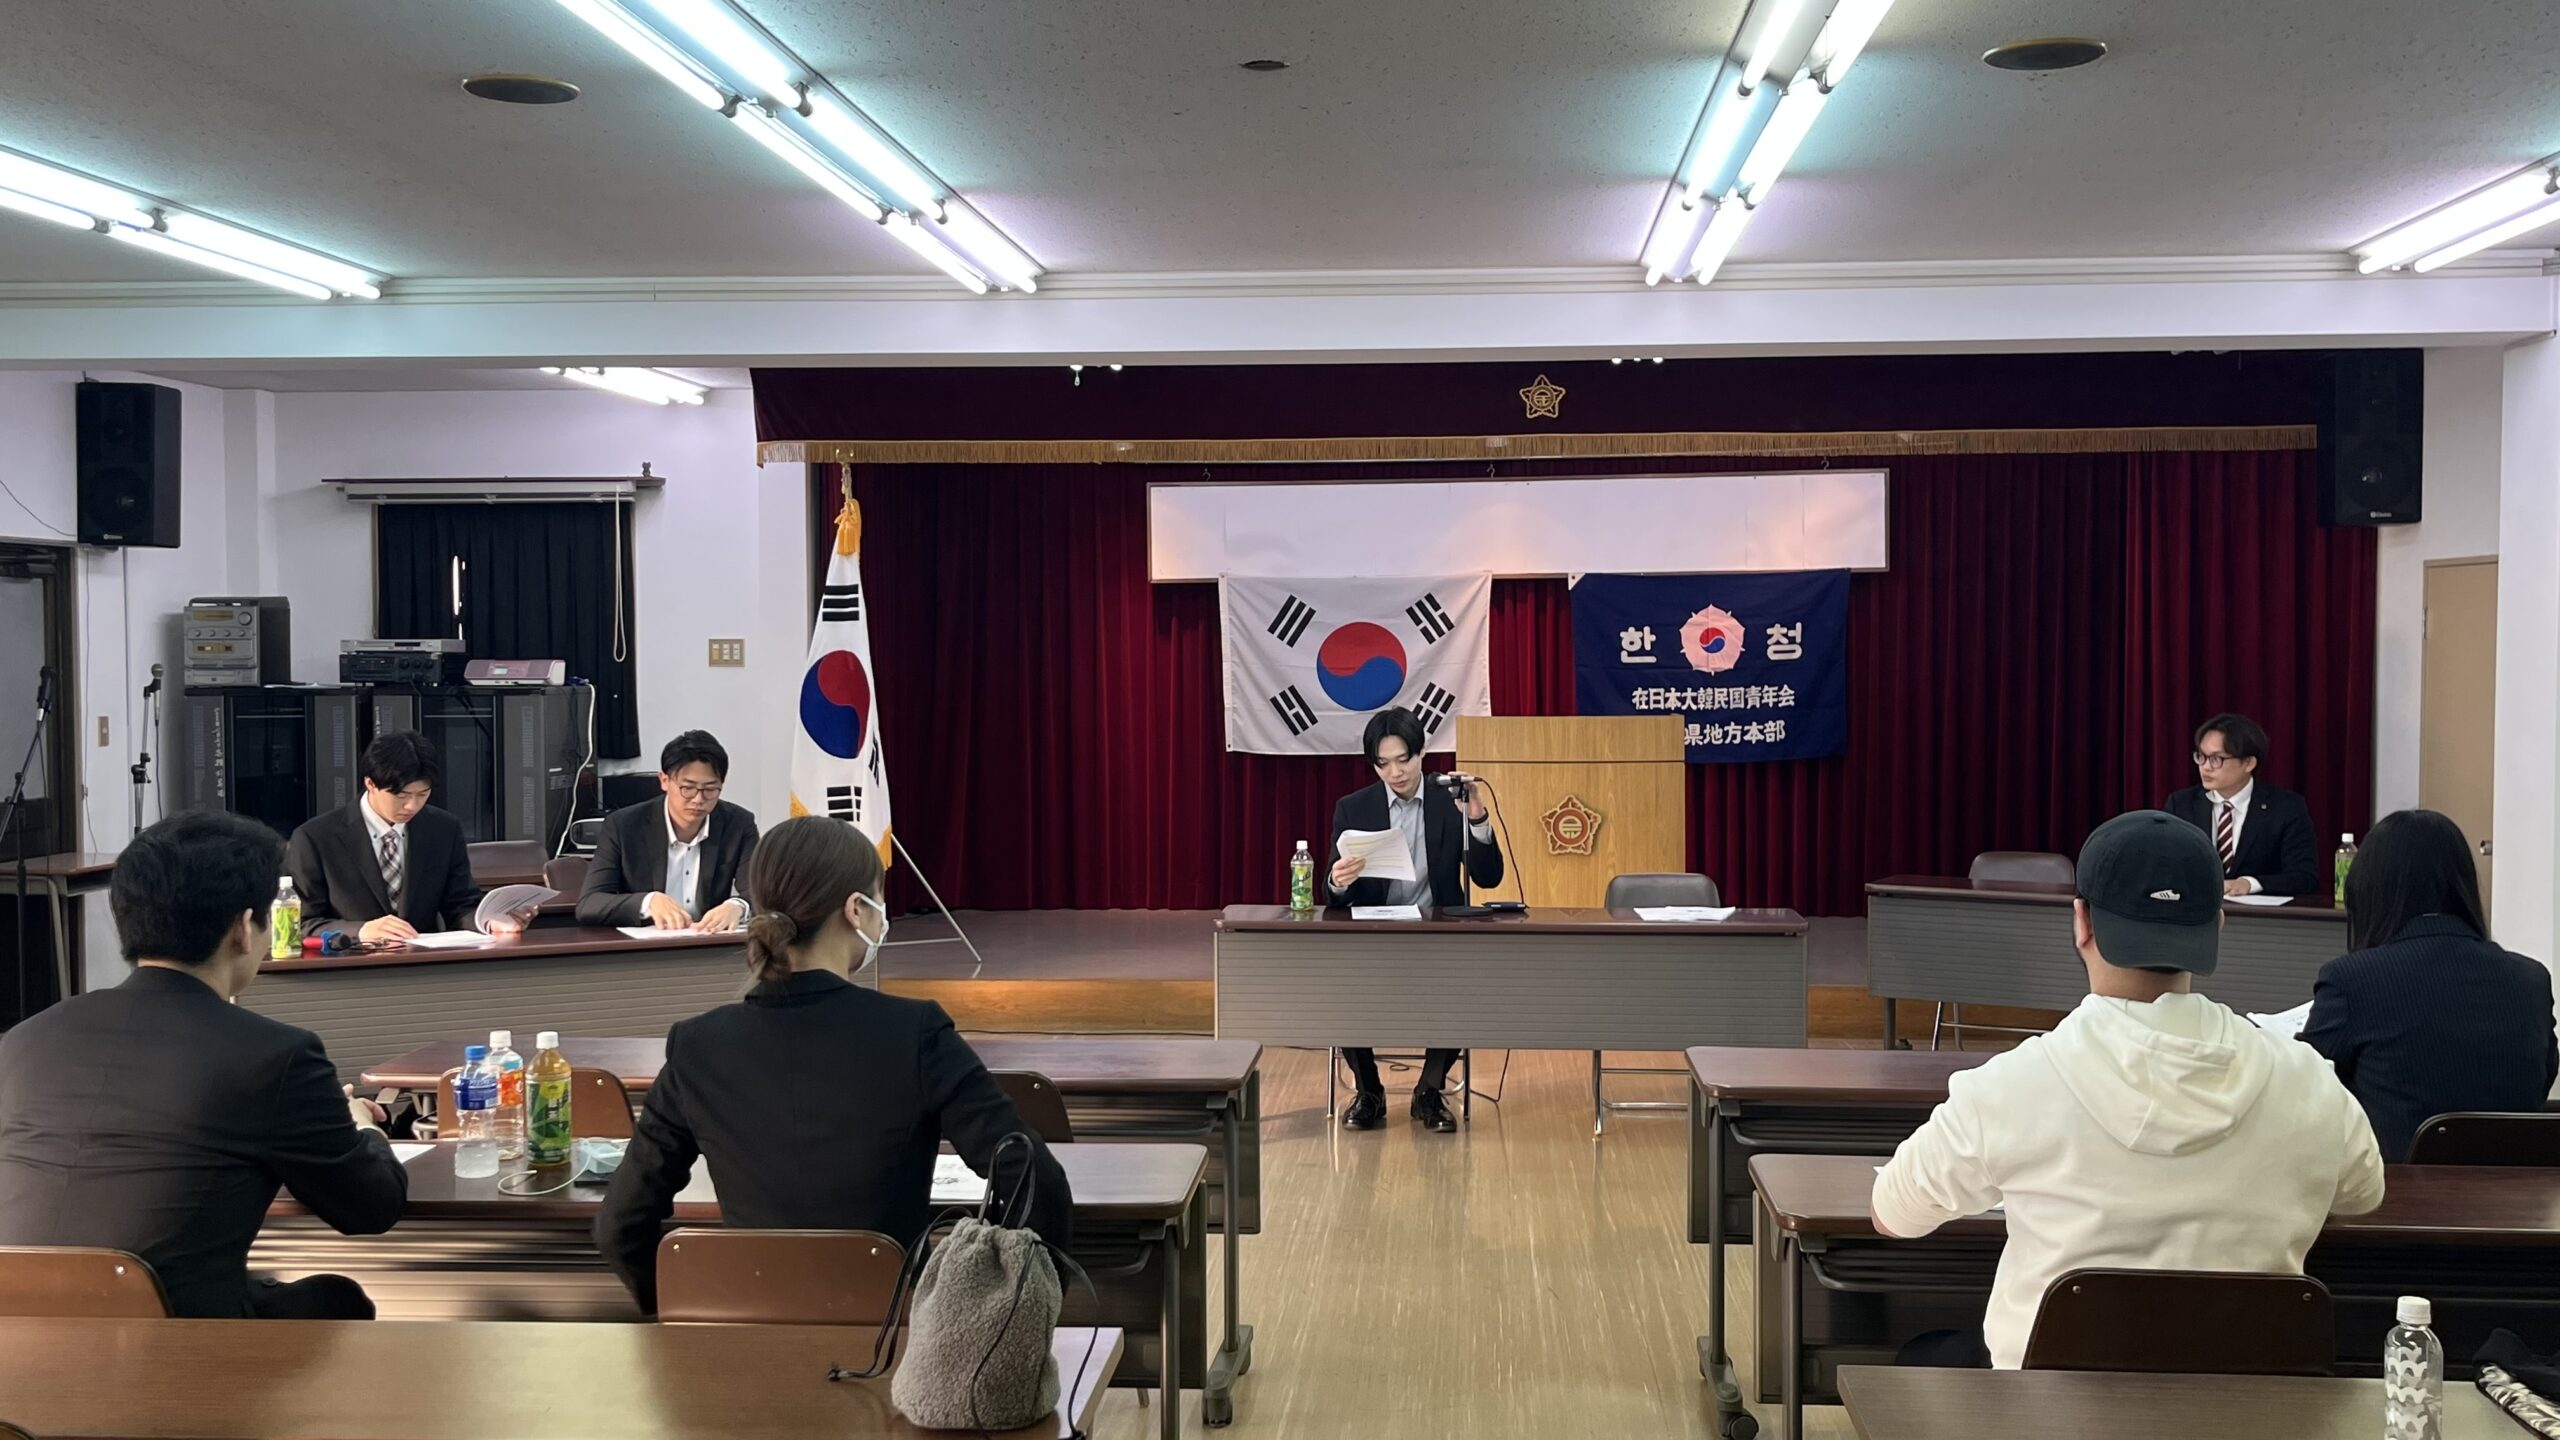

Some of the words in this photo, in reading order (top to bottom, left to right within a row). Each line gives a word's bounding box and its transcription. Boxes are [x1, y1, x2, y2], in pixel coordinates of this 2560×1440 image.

[1619, 625, 1657, 663] 한
[1766, 622, 1802, 661] 청
[1632, 684, 1795, 710] 在日本大韓民国青年会
[1684, 720, 1786, 746] 県地方本部
